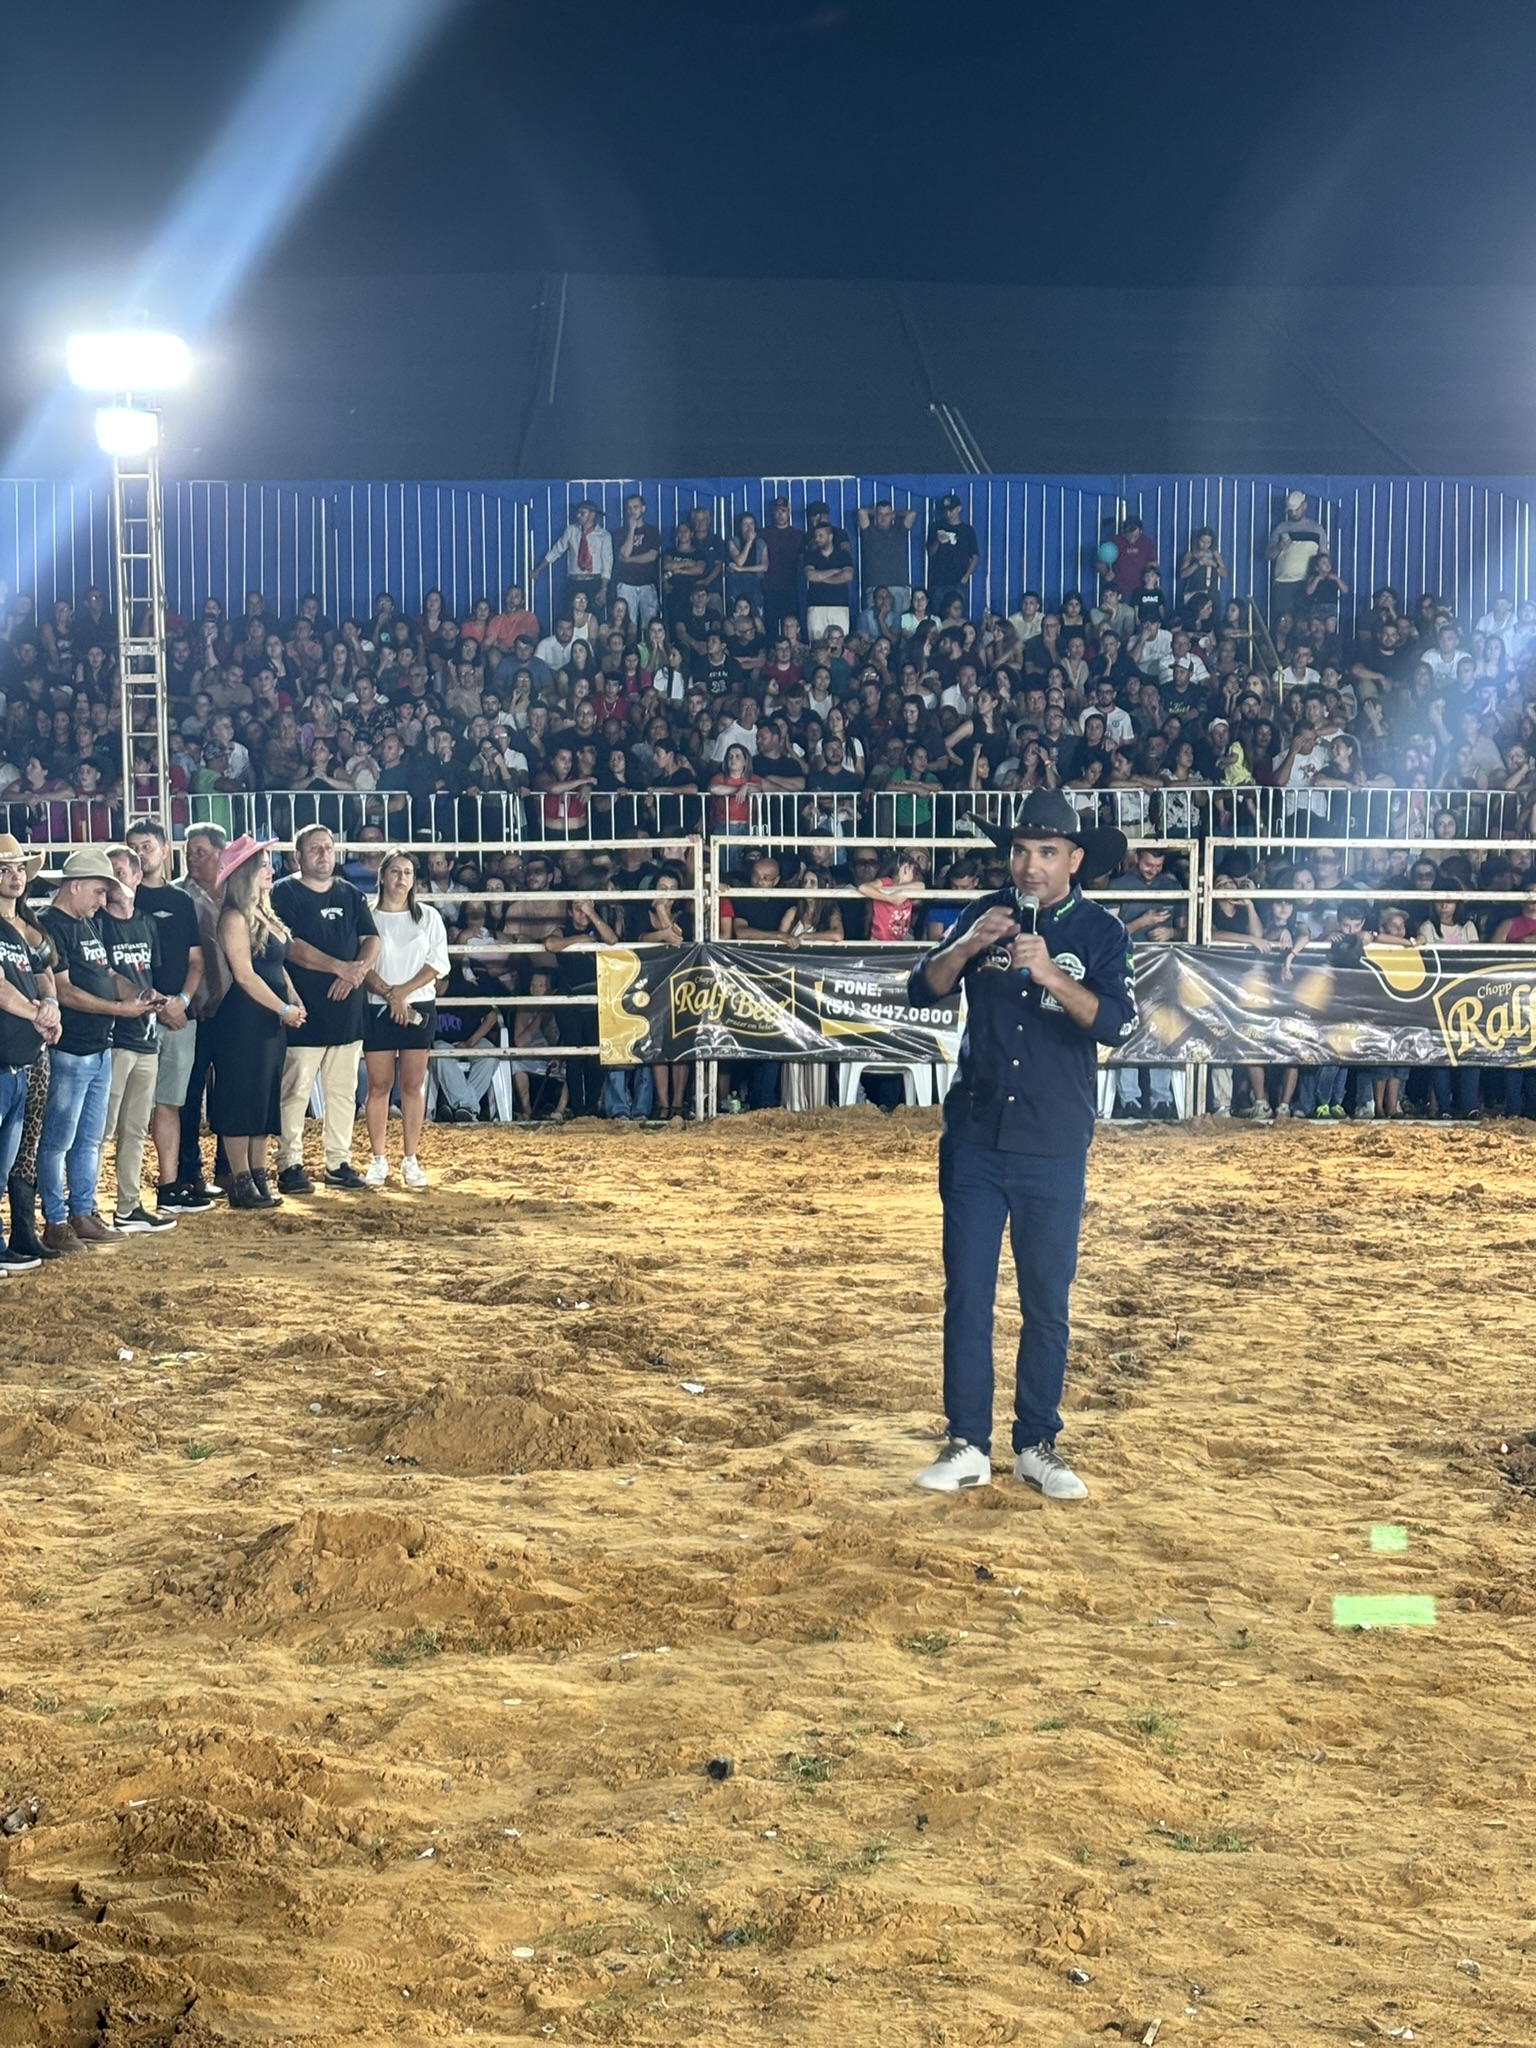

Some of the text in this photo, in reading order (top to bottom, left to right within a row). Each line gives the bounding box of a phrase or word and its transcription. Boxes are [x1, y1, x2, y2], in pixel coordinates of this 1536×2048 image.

[834, 979, 883, 997] FONE:
[1476, 981, 1513, 999] Chopp
[675, 980, 736, 1020] Ralf
